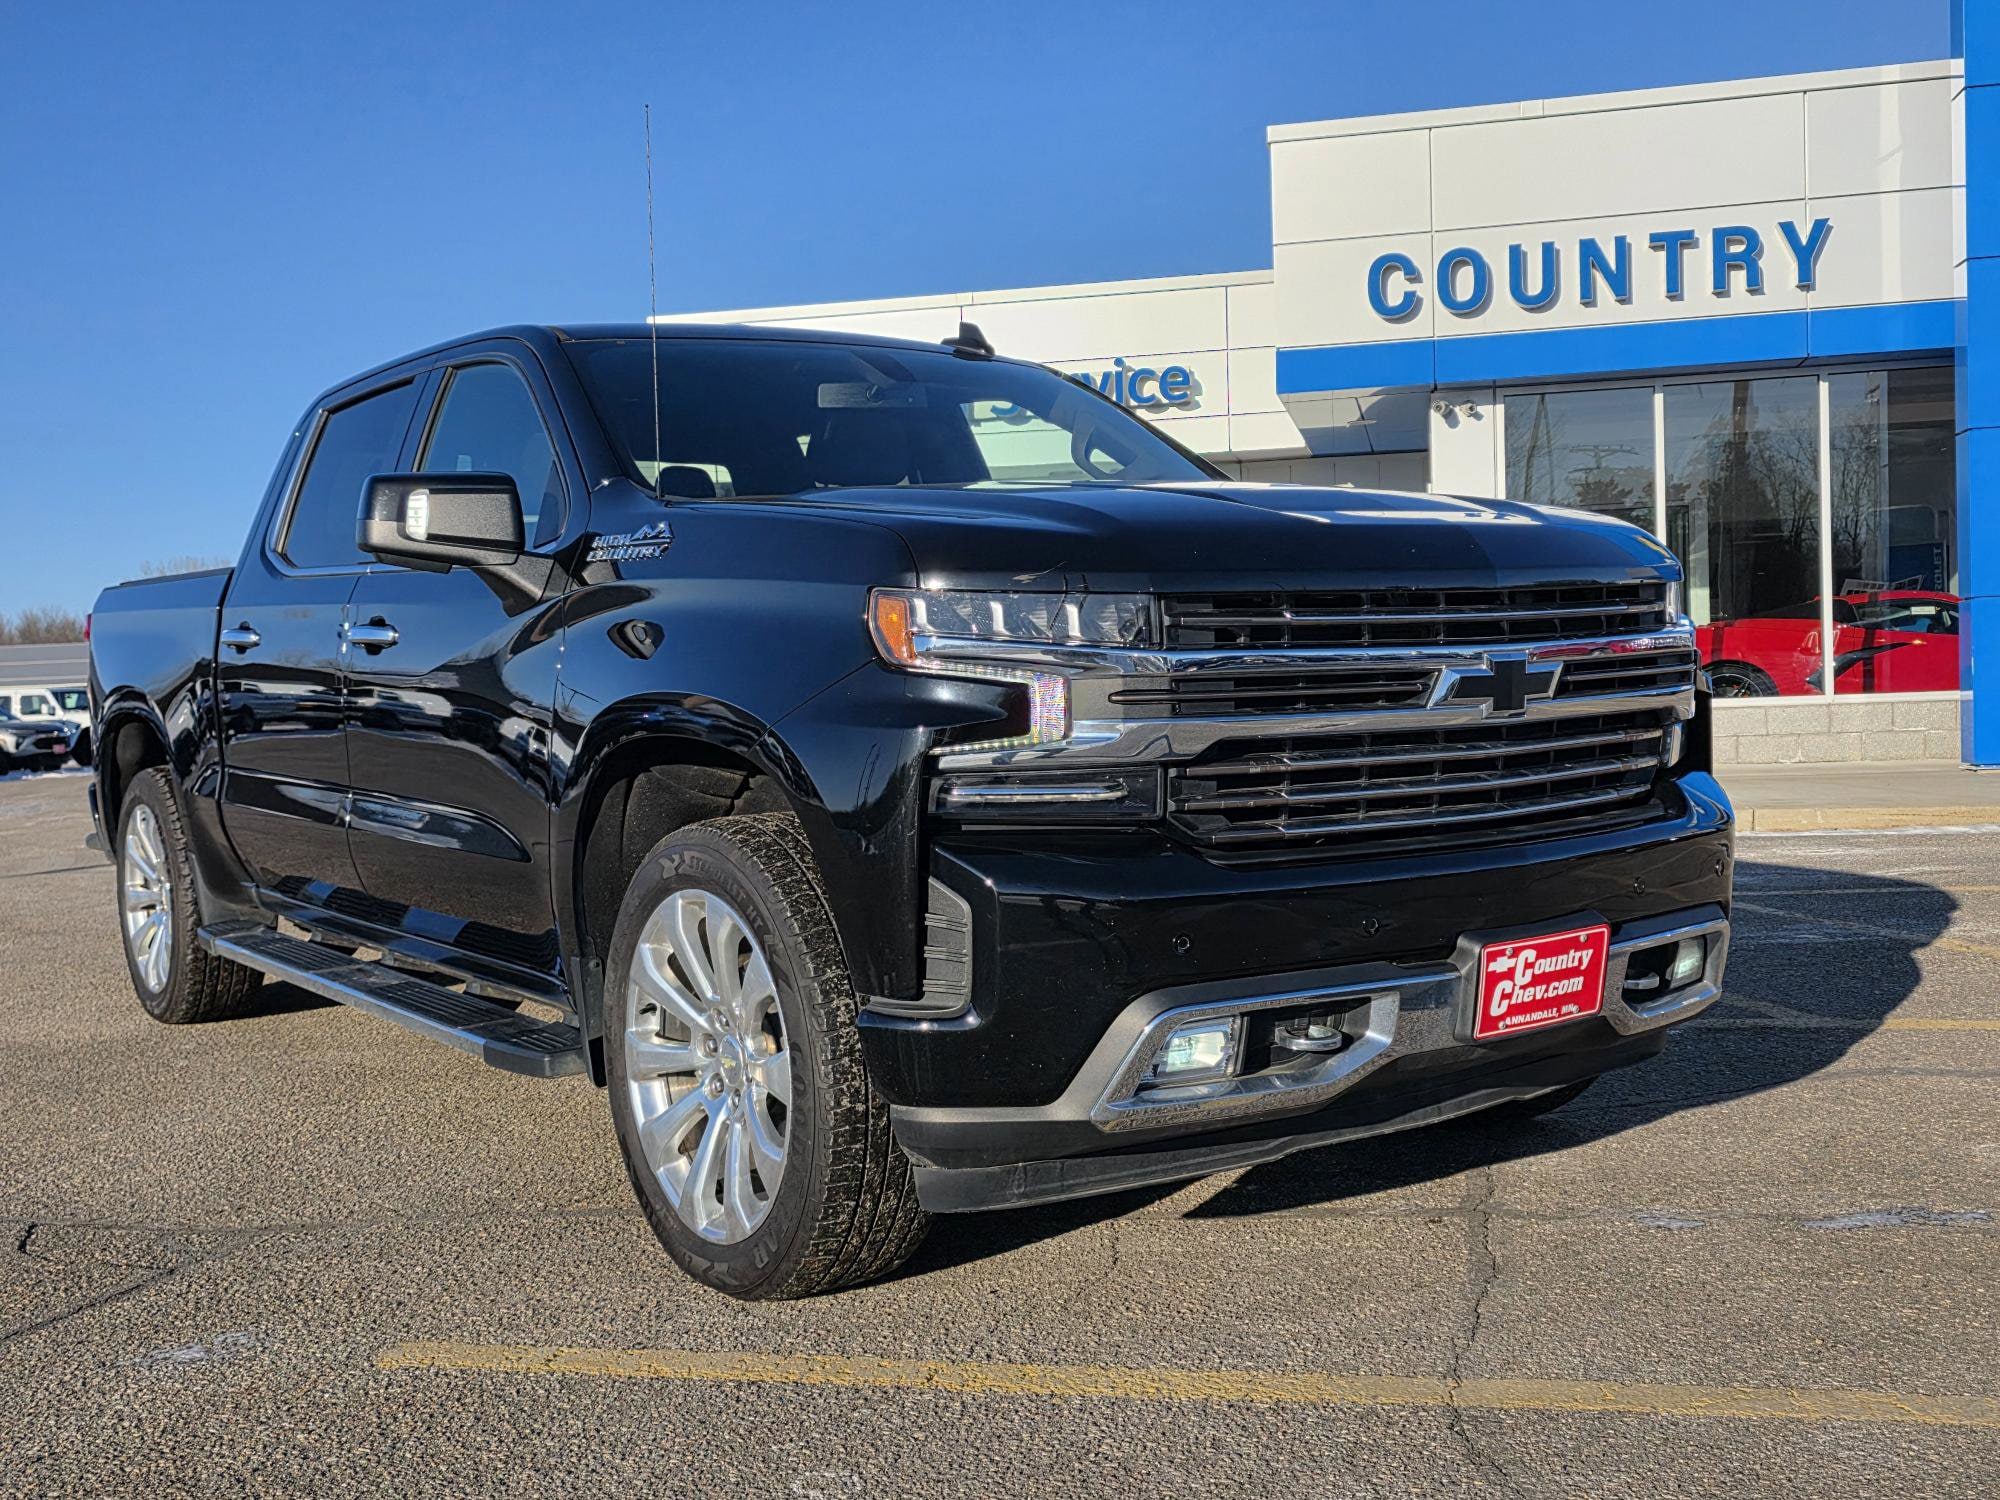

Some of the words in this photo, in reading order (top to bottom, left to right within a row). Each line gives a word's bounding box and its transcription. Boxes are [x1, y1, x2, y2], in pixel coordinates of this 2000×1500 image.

[1367, 217, 1831, 320] COUNTRY
[1514, 948, 1594, 987] Country
[1489, 976, 1585, 1018] Chev.com
